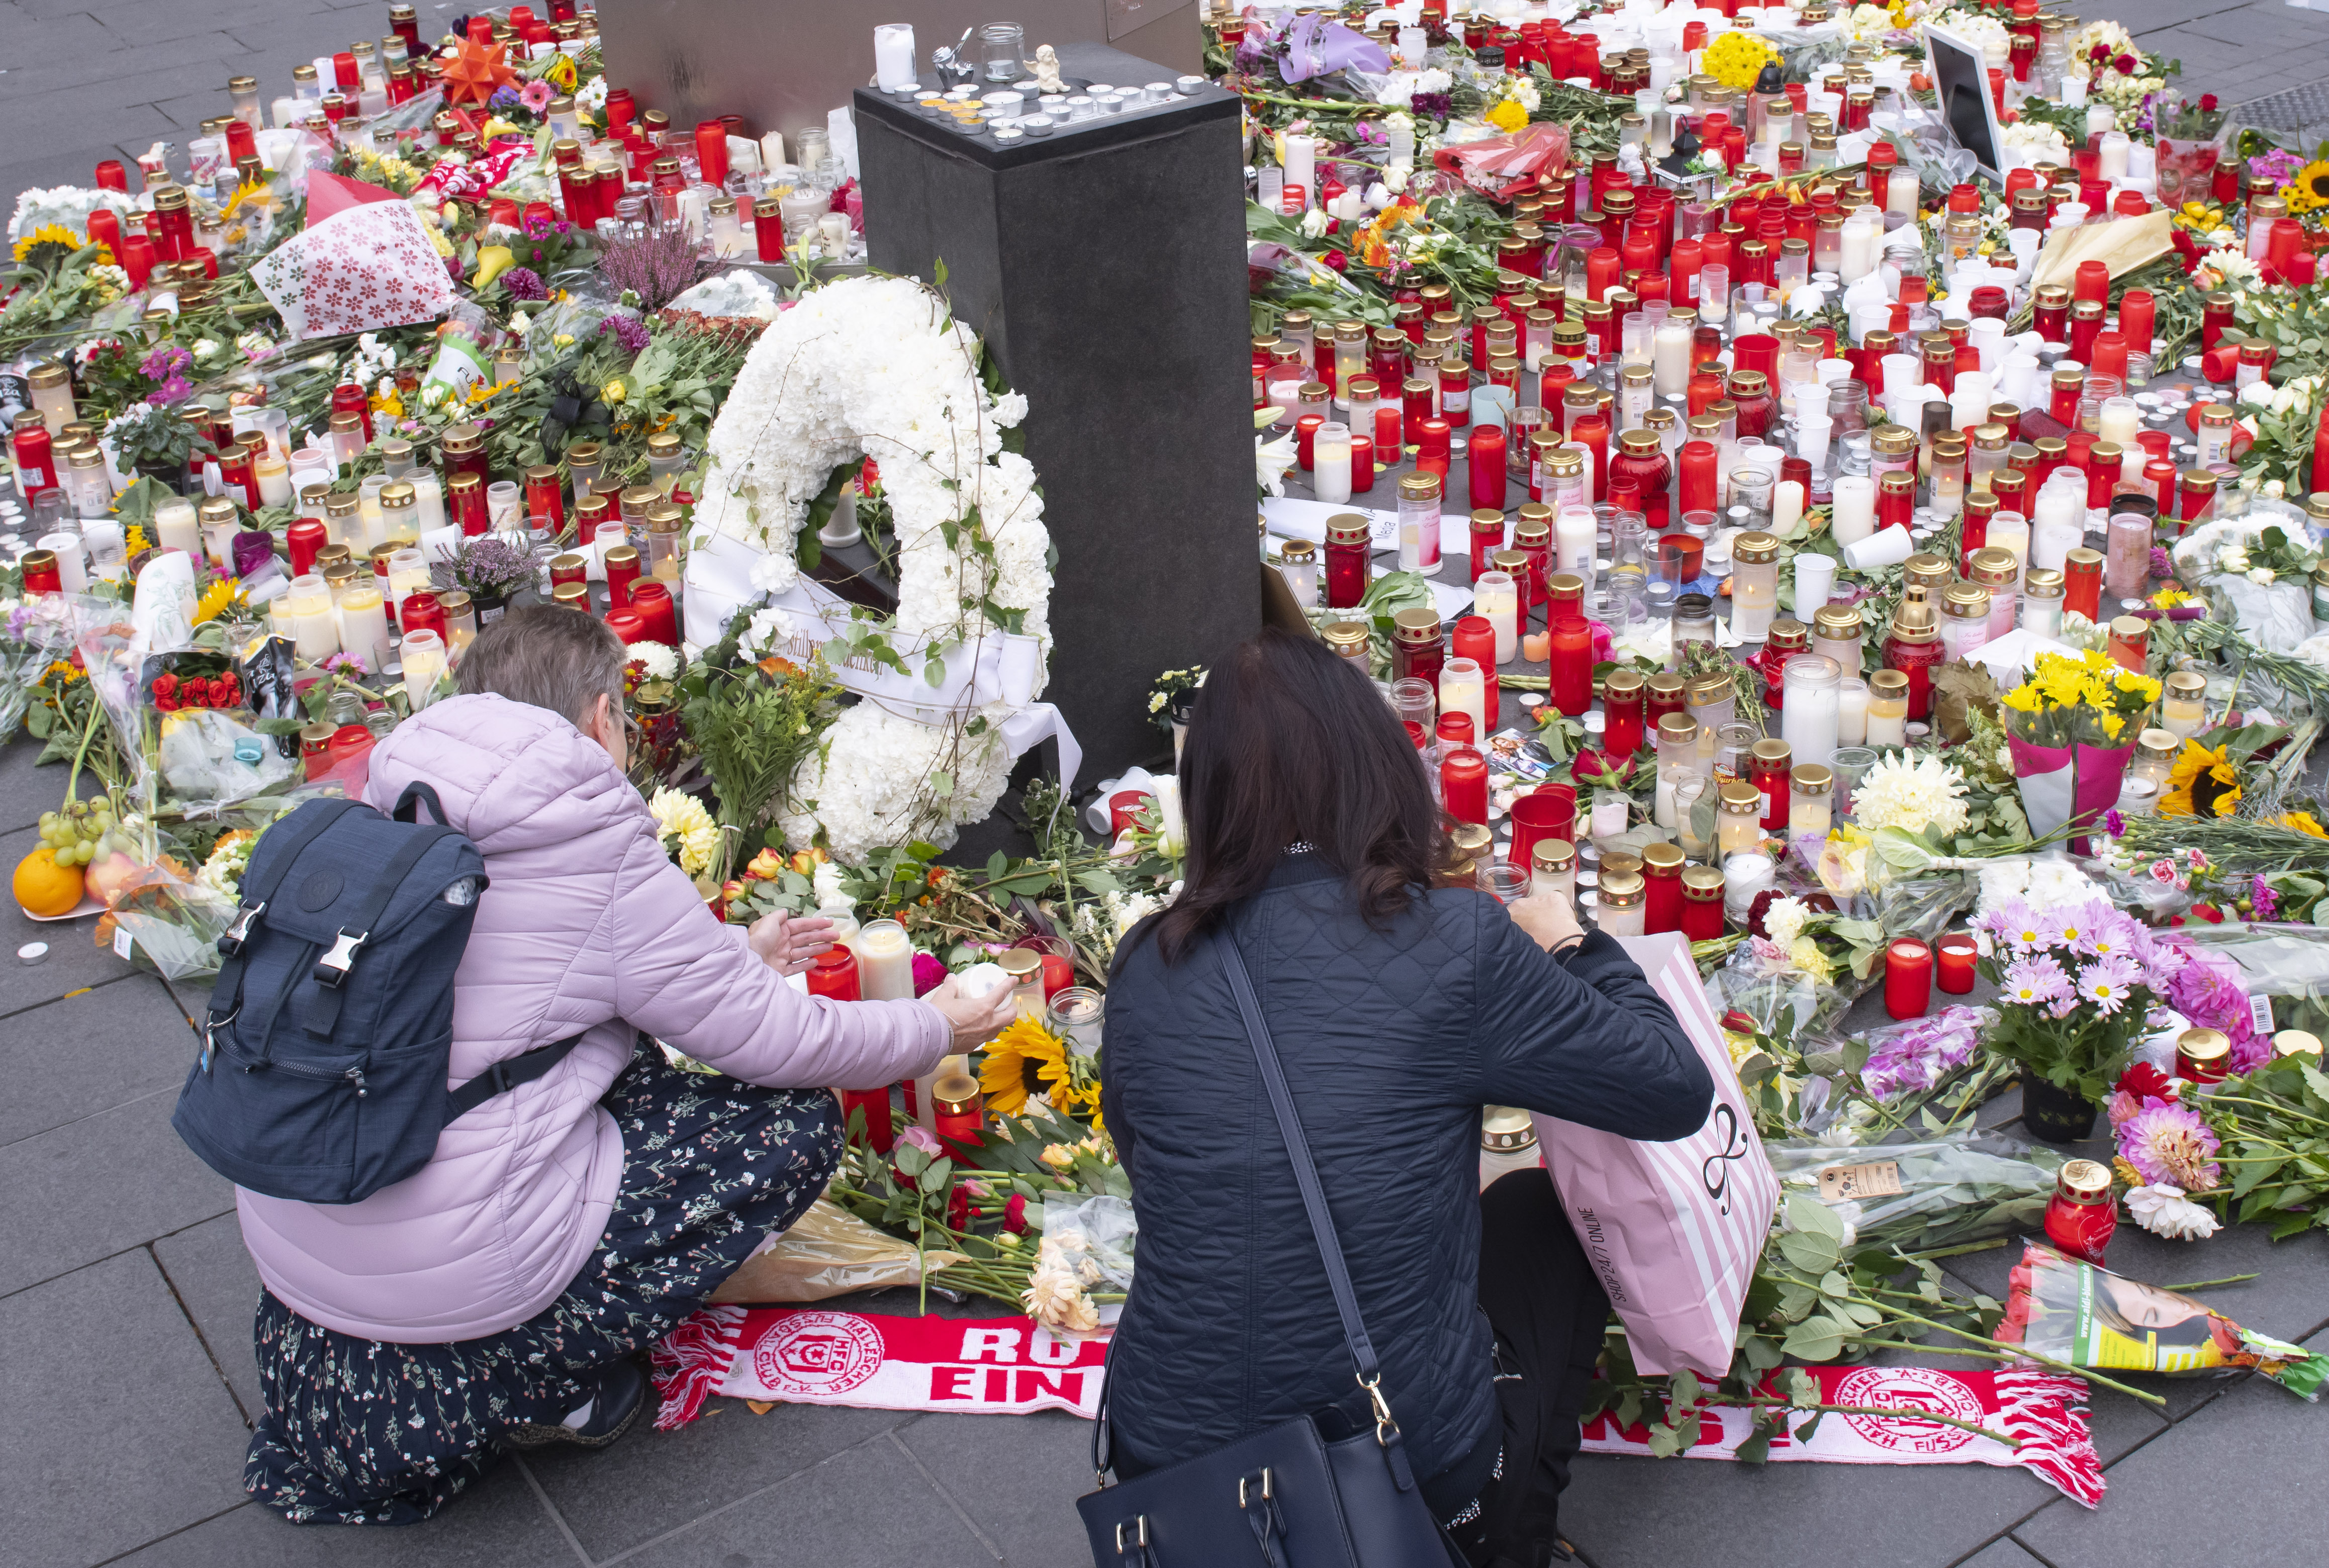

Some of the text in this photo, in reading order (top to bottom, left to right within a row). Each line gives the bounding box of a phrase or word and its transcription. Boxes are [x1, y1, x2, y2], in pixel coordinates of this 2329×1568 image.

[1374, 521, 1396, 540] Media
[1577, 1207, 1627, 1302] SHOP 24/7 ONLINE
[2080, 1264, 2091, 1338] www.aldi-blumen.de
[830, 1339, 850, 1371] HFC
[929, 1366, 1084, 1406] EIN
